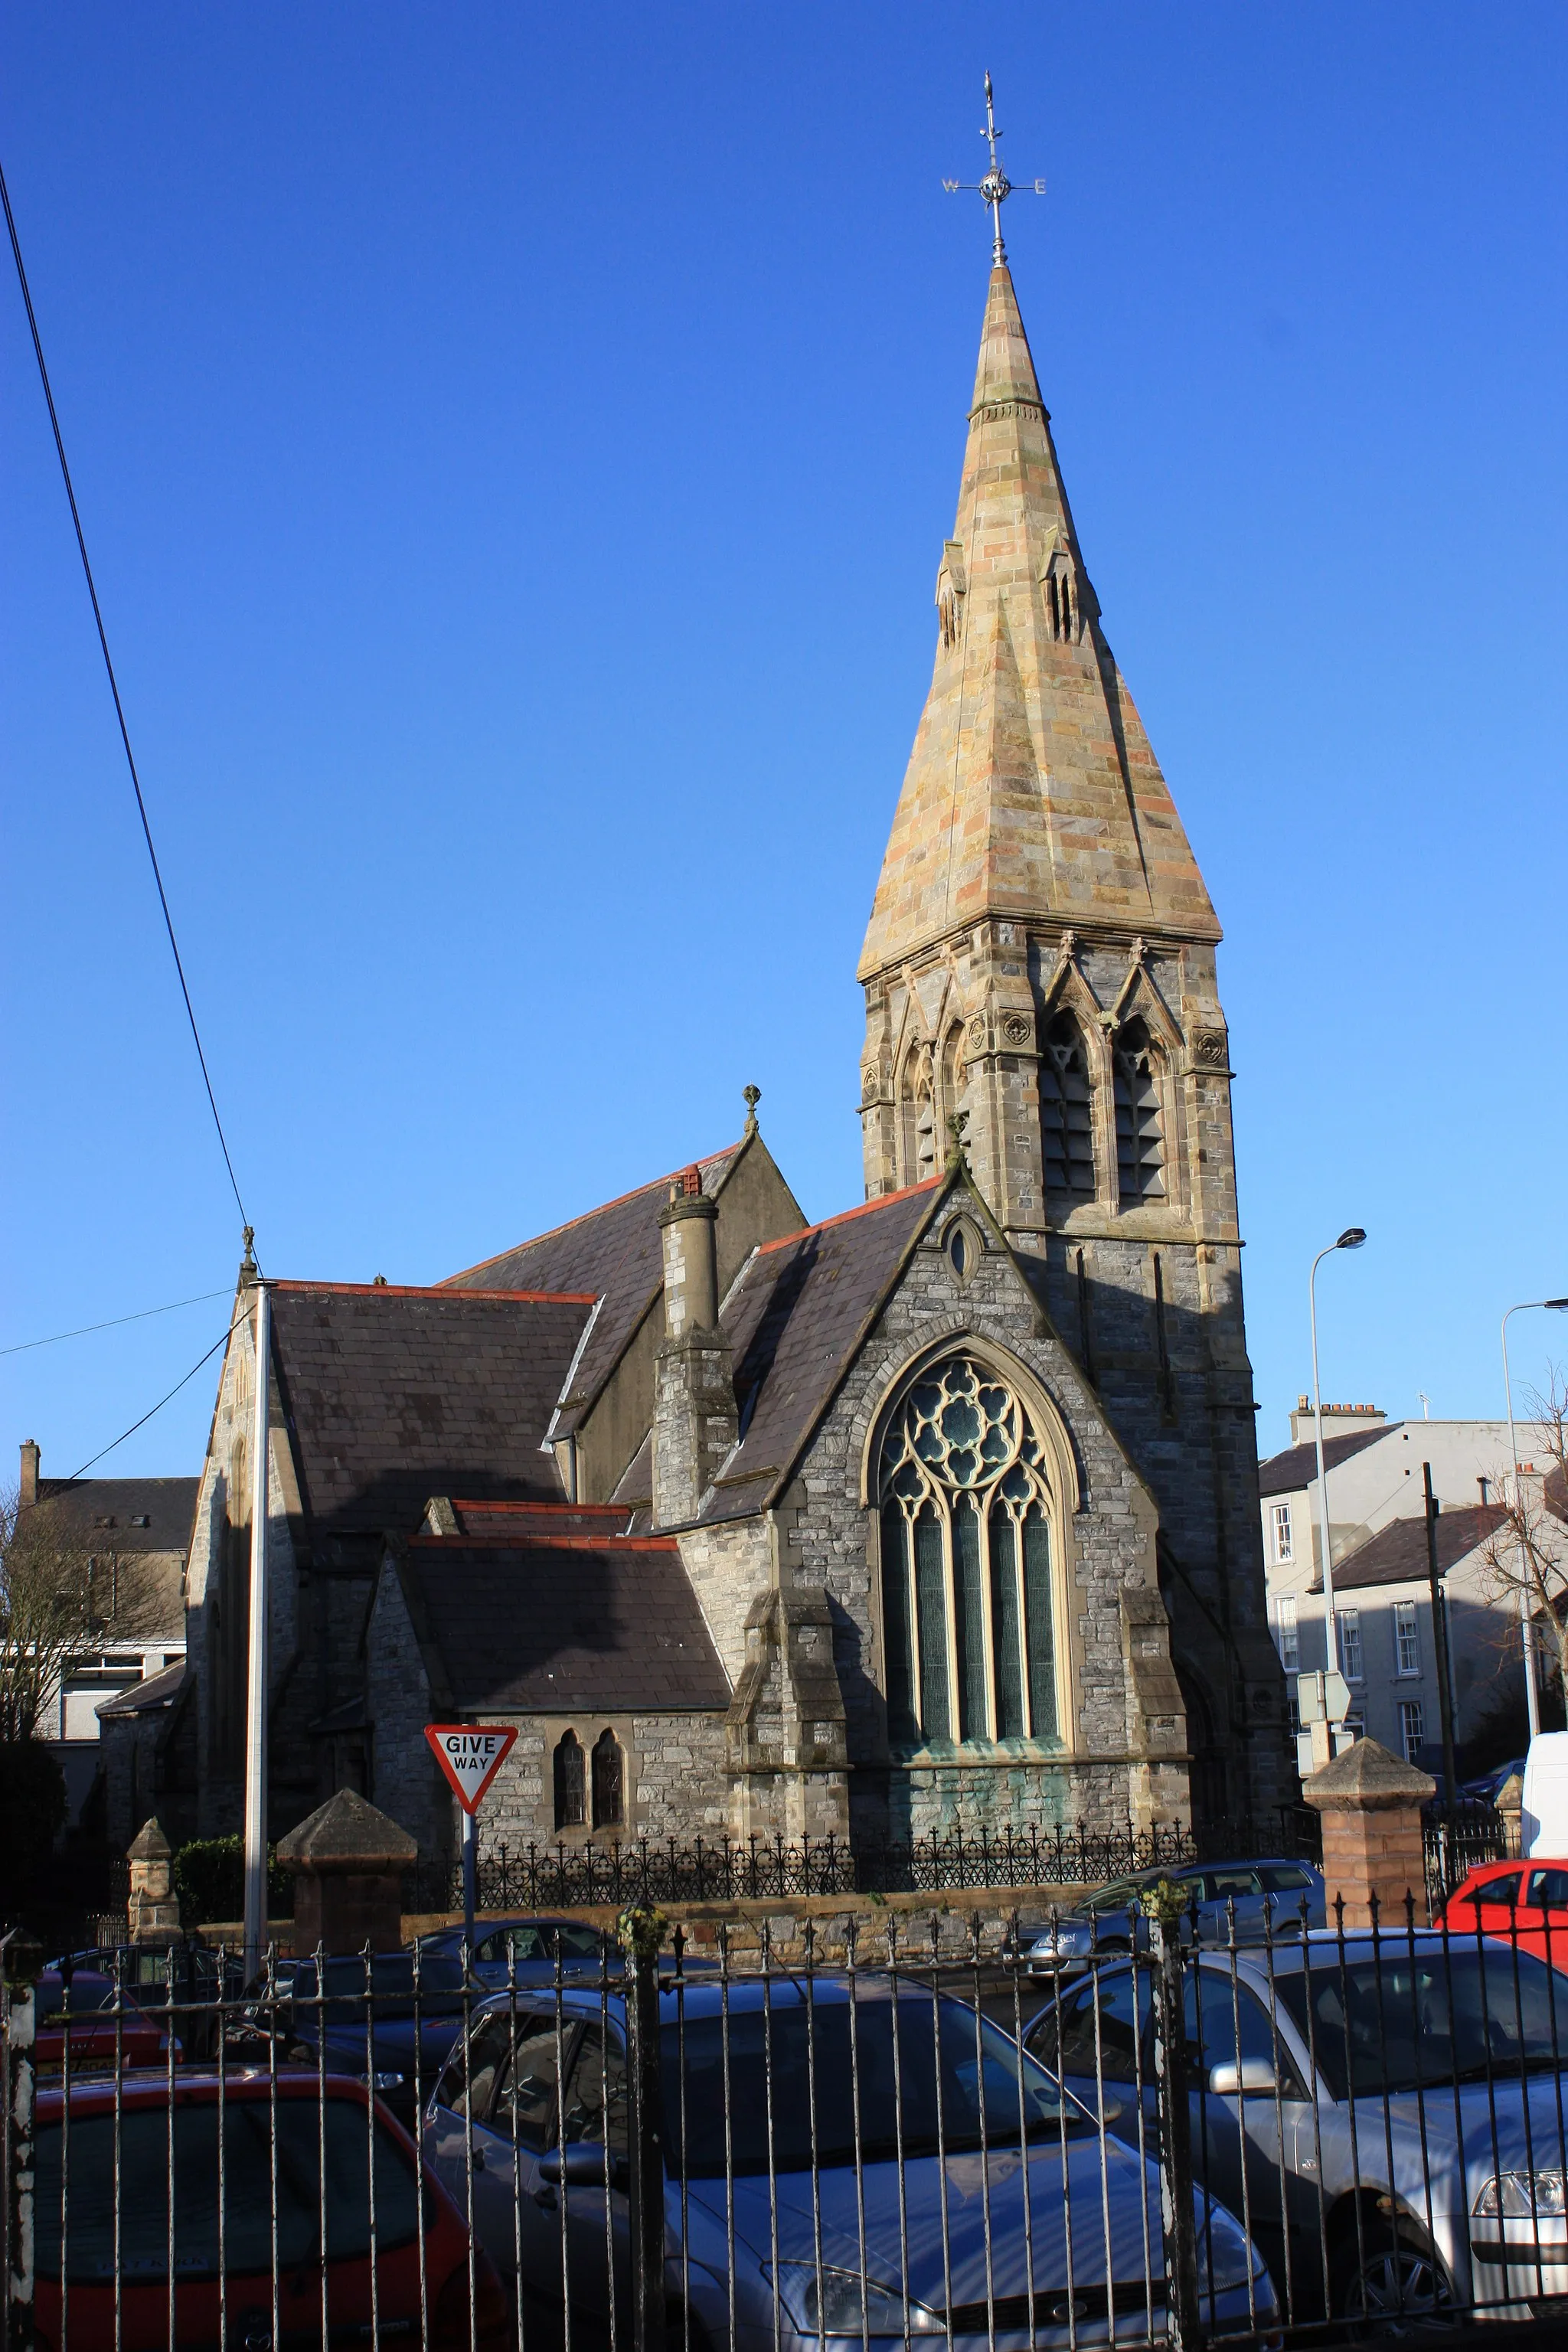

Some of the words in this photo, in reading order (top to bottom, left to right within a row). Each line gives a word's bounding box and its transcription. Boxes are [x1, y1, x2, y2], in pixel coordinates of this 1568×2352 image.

[942, 178, 959, 193] W
[1034, 178, 1046, 194] E
[446, 1736, 495, 1753] GIVE
[454, 1757, 488, 1769] WAY
